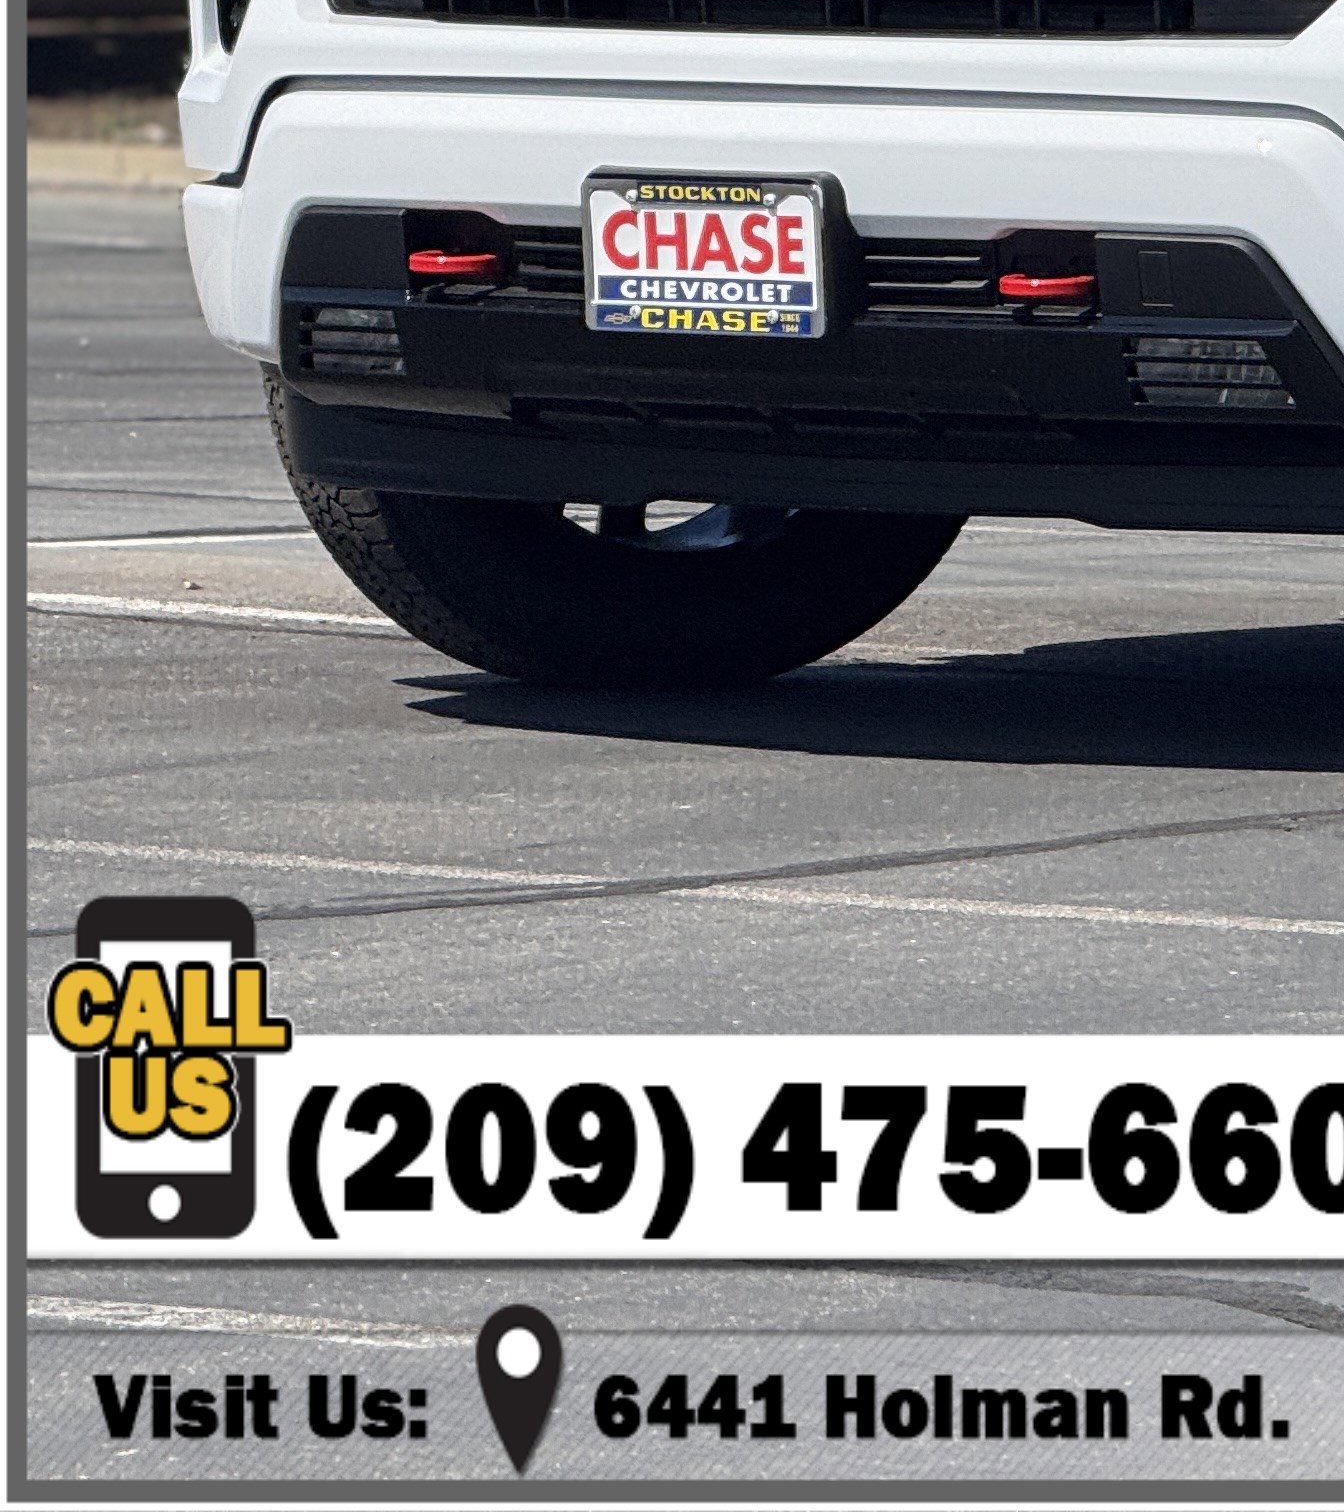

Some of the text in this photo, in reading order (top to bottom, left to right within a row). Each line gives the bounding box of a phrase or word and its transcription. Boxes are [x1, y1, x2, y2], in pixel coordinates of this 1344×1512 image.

[640, 184, 761, 203] STOCKTON
[602, 209, 806, 275] CHASE
[620, 279, 793, 303] CHEVROLET
[641, 307, 771, 333] CHASE
